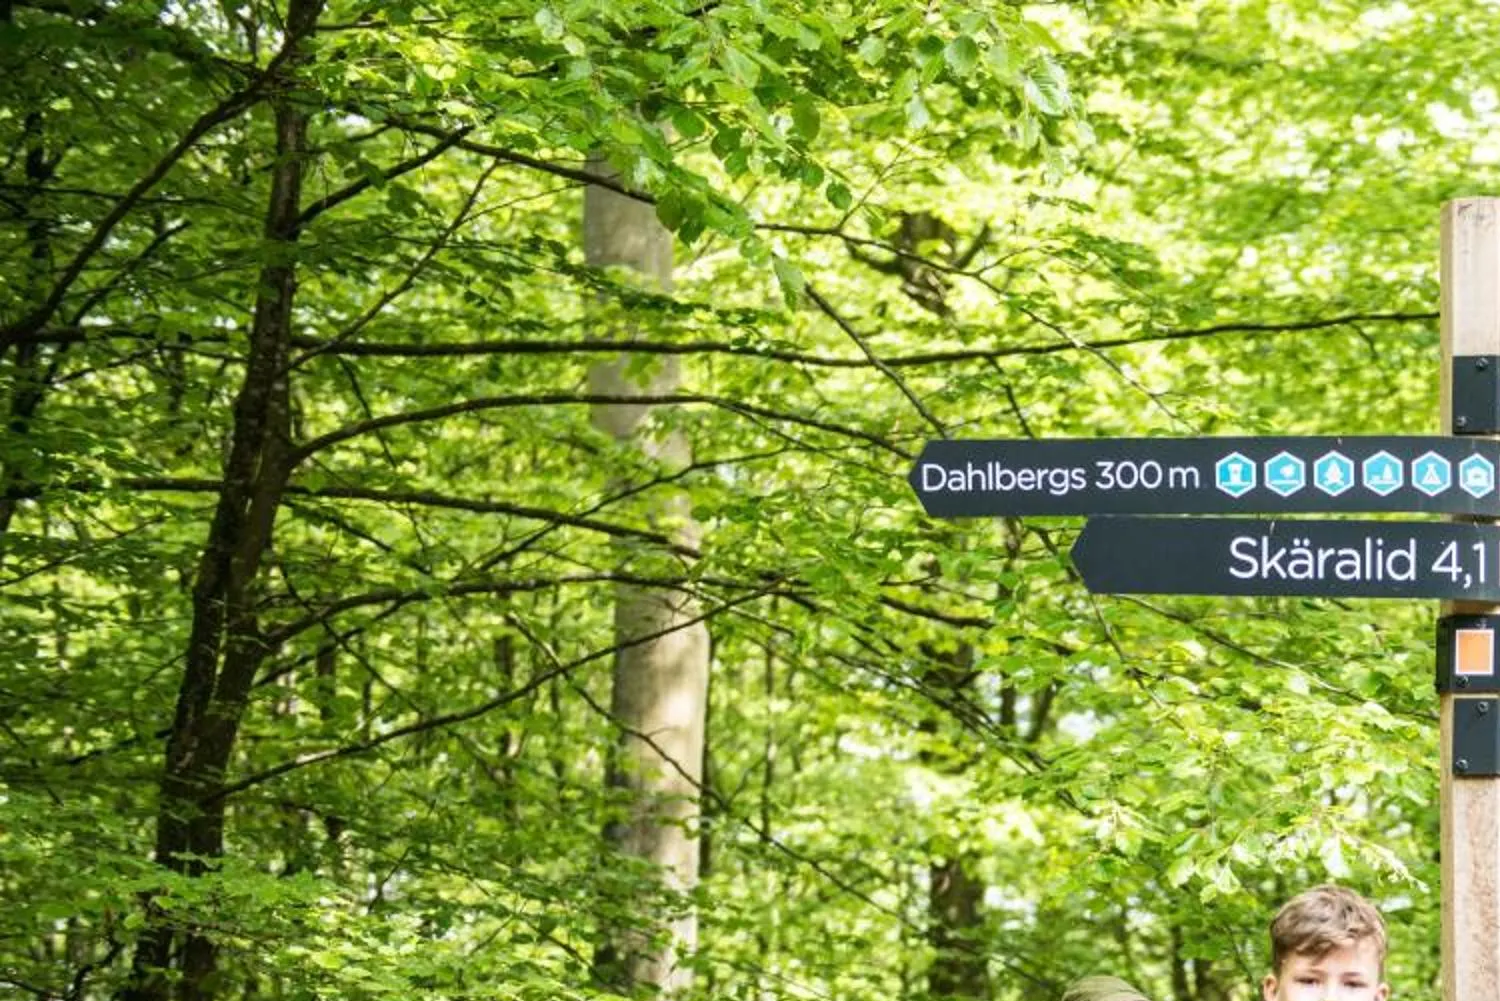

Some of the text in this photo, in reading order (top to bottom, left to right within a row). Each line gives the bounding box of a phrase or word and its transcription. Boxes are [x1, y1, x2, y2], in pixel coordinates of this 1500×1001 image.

[921, 460, 1200, 496] Dahlbergs 300 m
[1228, 535, 1486, 589] Skäralid 4,1
